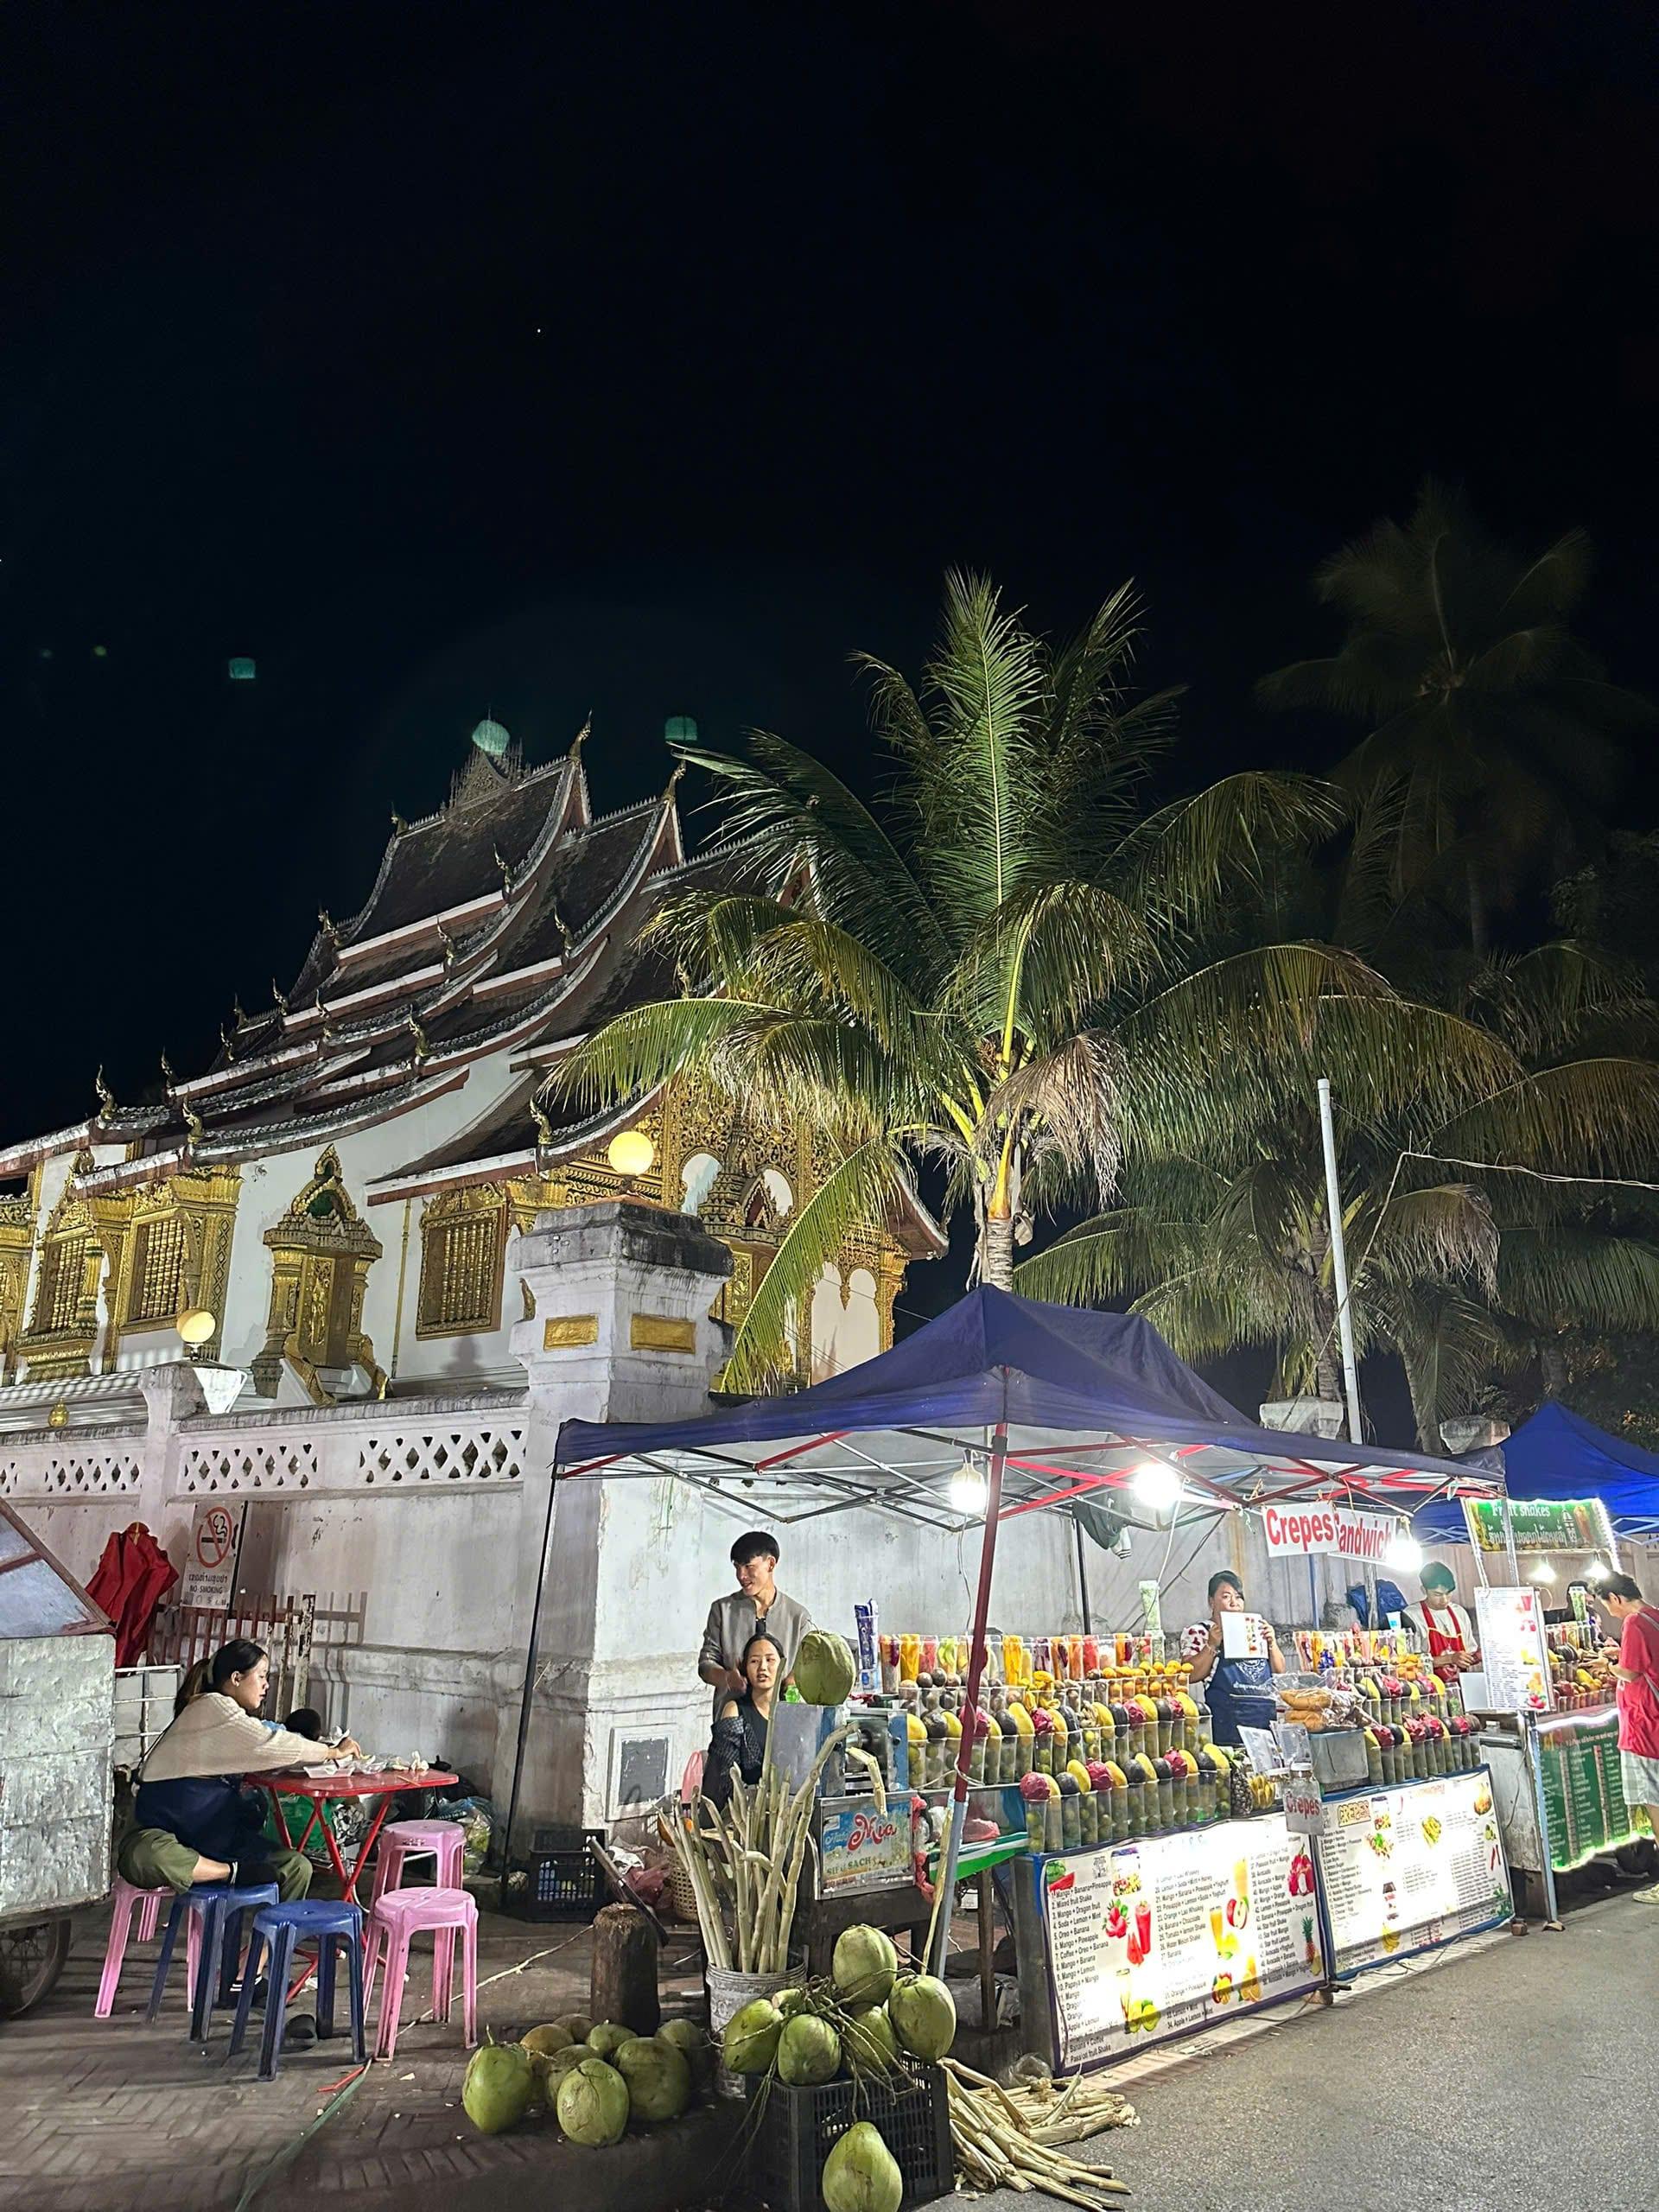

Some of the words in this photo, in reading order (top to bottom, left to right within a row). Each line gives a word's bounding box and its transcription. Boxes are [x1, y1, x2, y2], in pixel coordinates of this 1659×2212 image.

[1520, 1502, 1551, 1517] shakes
[1266, 1509, 1335, 1552] Crepes
[200, 1585, 223, 1594] SMOKING
[1055, 1889, 1071, 1899] Mango
[1079, 1893, 1092, 1903] Shake
[1057, 1908, 1071, 1920] Mango
[1076, 1904, 1091, 1915] Dragon
[1057, 1919, 1069, 1928] Soda
[1072, 1915, 1088, 1924] Lemon
[1073, 1924, 1089, 1935] Banana
[1059, 1938, 1074, 1950] Mango
[1077, 1932, 1098, 1944] Pineapple
[1059, 1948, 1074, 1959] Coffee
[1092, 1940, 1109, 1949] Banana
[1060, 1959, 1076, 1971] Mango
[1079, 1953, 1096, 1964] Banana
[1061, 1969, 1077, 1981] Mango
